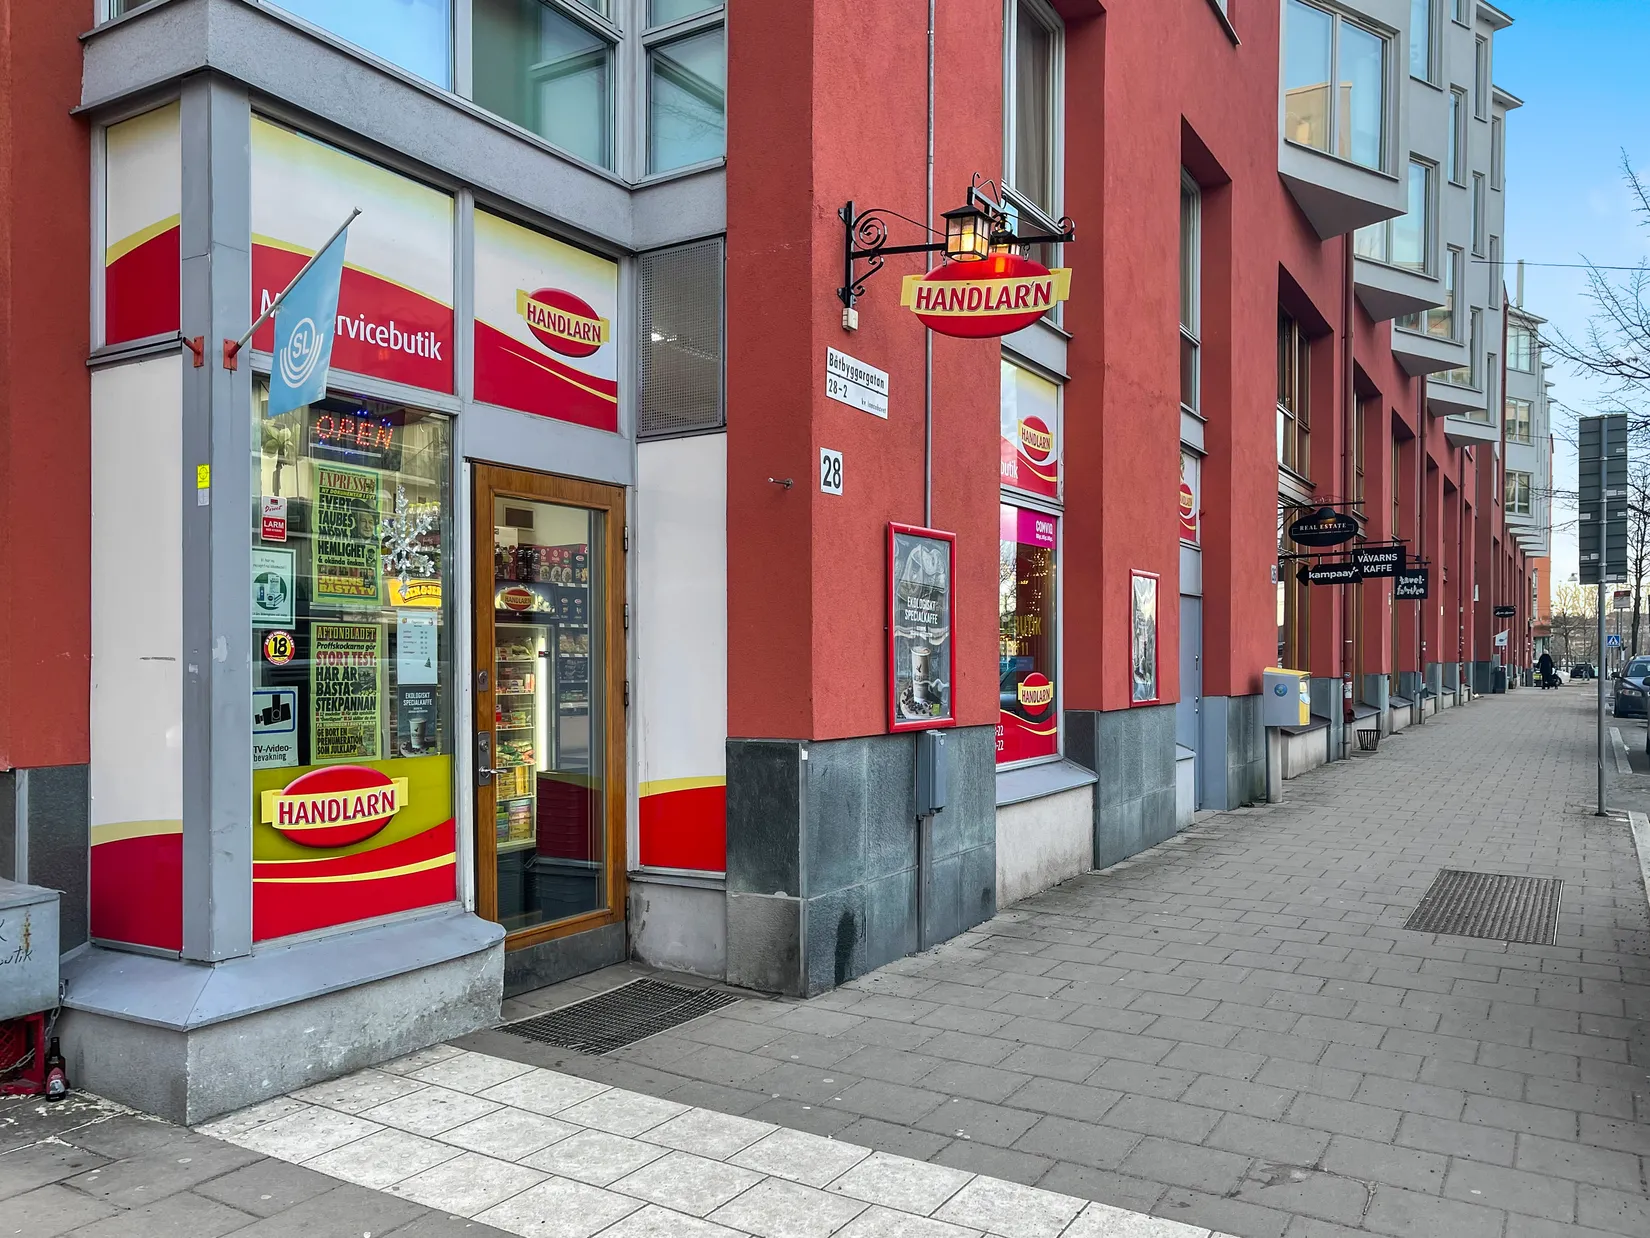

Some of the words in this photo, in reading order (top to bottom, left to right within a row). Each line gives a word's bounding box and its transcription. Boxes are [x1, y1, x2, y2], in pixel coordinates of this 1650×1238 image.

[915, 281, 1052, 311] HANDLAR'N
[527, 302, 601, 342] HANDLAR'N
[292, 331, 311, 358] SL
[334, 313, 442, 361] rvicebutik
[829, 352, 885, 389] Båtbyggargatan
[828, 378, 848, 398] 28-2
[316, 415, 394, 449] OPEN
[822, 454, 842, 490] 28
[1000, 460, 1019, 479] butik
[319, 494, 352, 512] EVERT
[264, 520, 285, 529] LARM
[319, 510, 354, 529] TAUBES
[1319, 522, 1347, 530] ESTATE
[317, 540, 366, 558] HEMLIGHET
[1357, 553, 1398, 563] VÄVARNS
[1308, 570, 1354, 580] kampaay
[1363, 564, 1393, 573] KAFFE
[359, 586, 375, 595] TV
[317, 627, 376, 640] AFTONBLADET
[272, 636, 288, 656] 18
[365, 643, 376, 651] gör
[316, 651, 350, 666] STORT
[351, 651, 377, 666] TEST:
[316, 666, 340, 681] HÄR
[341, 666, 358, 681] ÄR
[316, 680, 351, 696] BÄSTA
[315, 697, 377, 711] STEKPANNAN
[995, 725, 1004, 737] -22
[253, 745, 292, 753] TV-/video-
[995, 739, 1004, 751] -22
[253, 752, 287, 761] bevakning
[278, 789, 395, 825] HANDLAR'N
